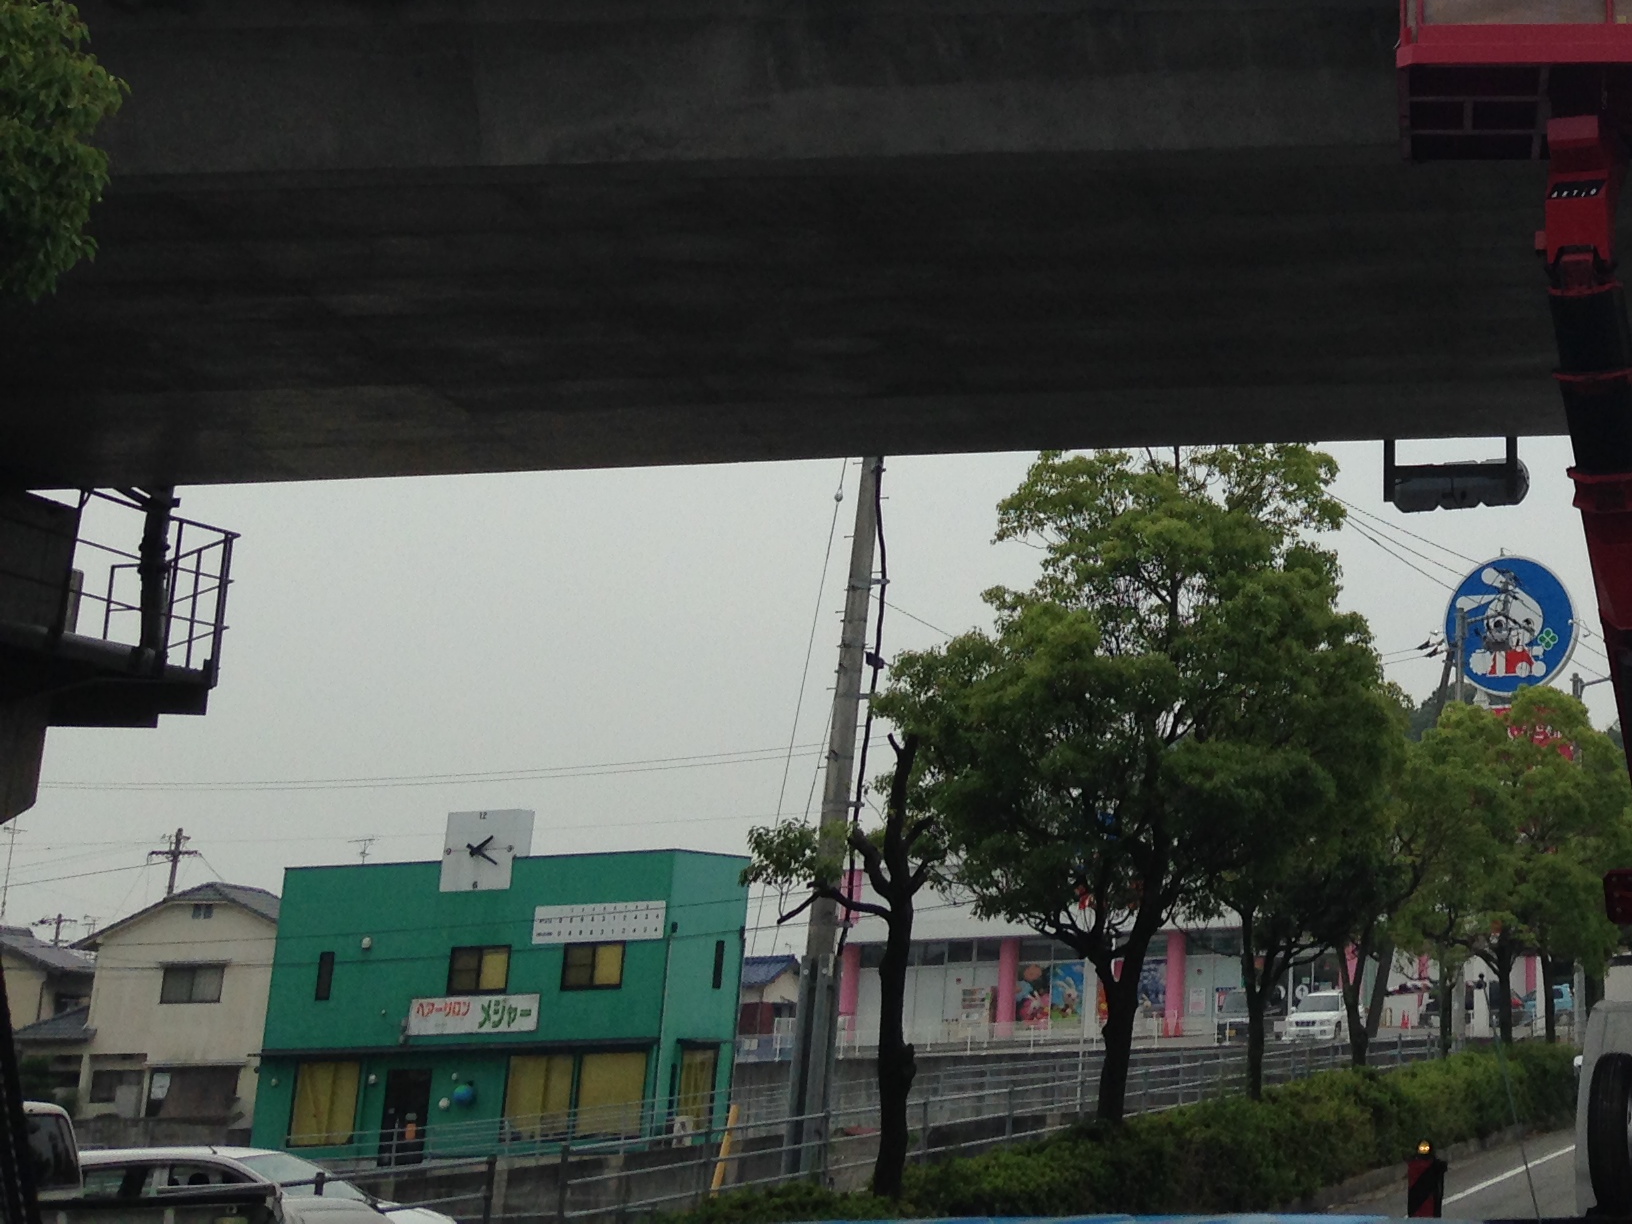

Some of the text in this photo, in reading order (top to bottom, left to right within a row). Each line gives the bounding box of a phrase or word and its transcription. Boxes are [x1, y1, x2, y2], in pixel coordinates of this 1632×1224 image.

[479, 811, 487, 820] 12
[416, 998, 532, 1029] ヘアーサロン メジャー
